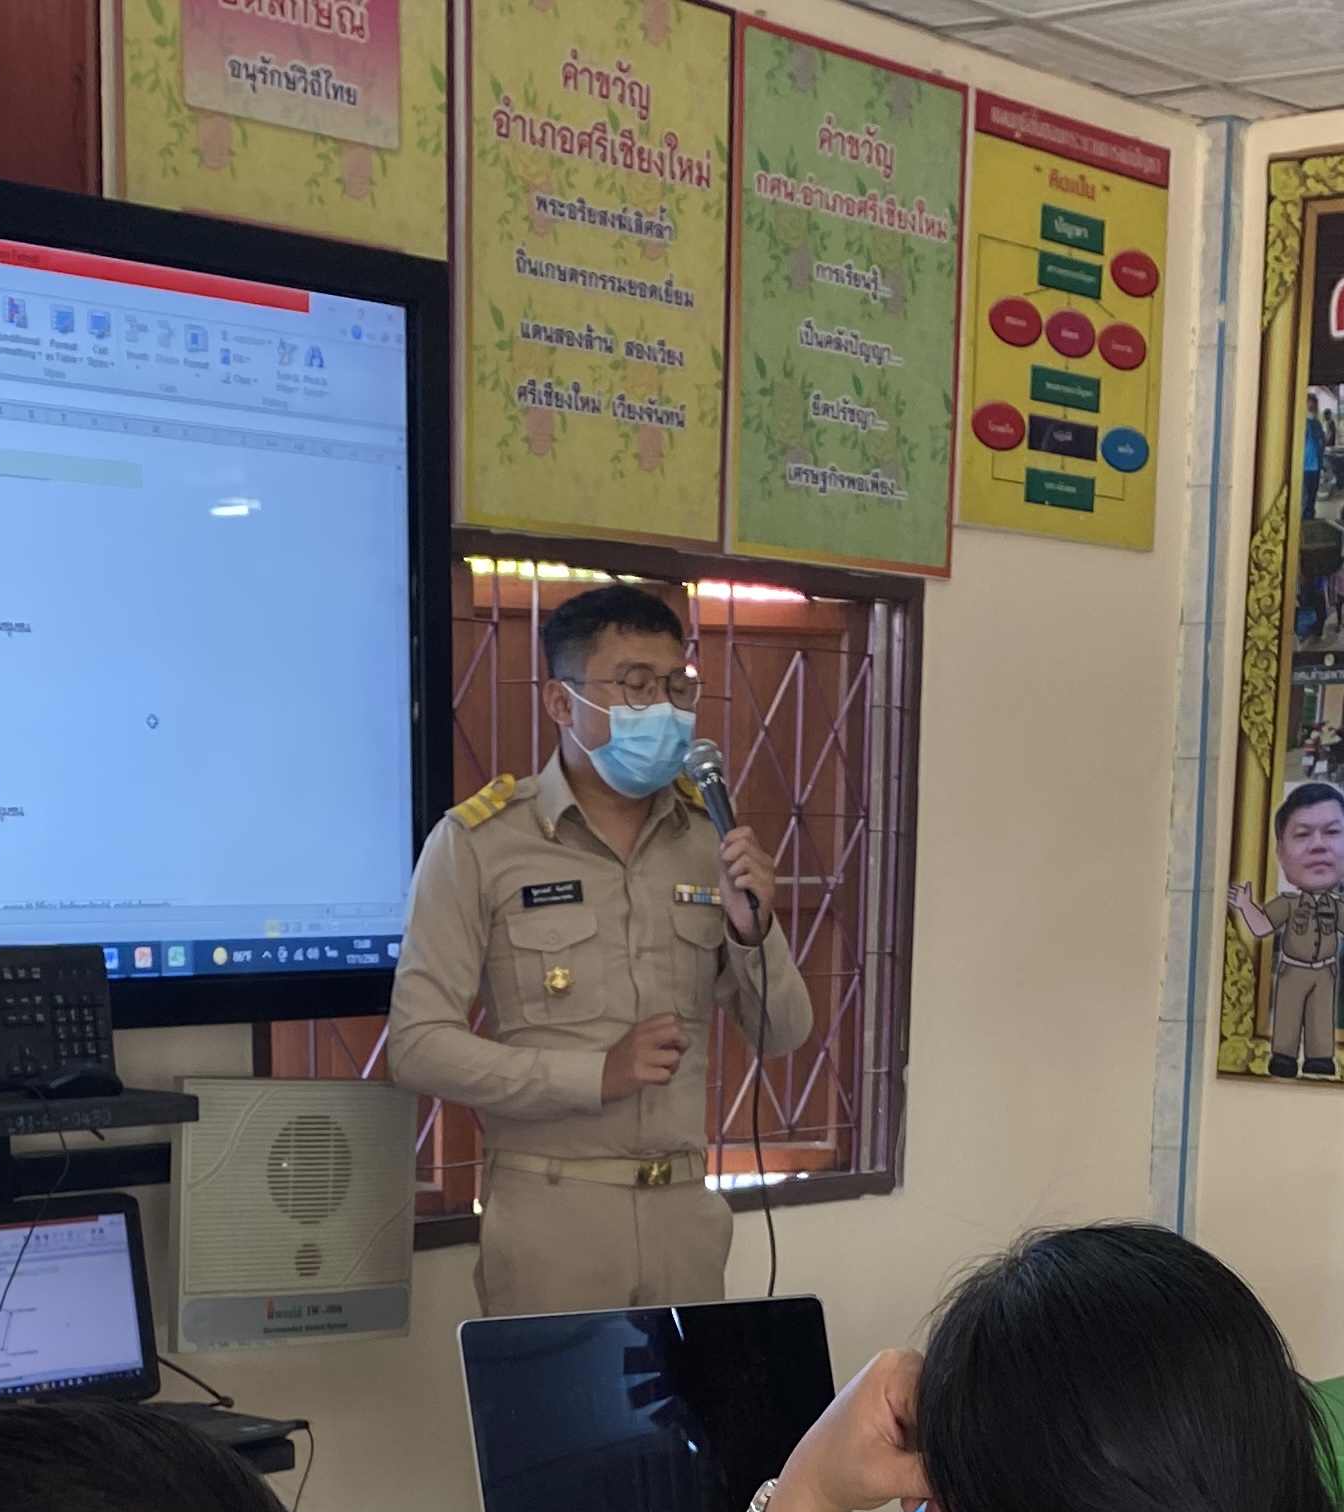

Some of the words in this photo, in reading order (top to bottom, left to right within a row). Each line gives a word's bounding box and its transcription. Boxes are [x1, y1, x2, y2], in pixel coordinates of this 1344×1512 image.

[228, 55, 357, 107] อนุรักษ์วิถีไทย
[561, 48, 651, 121] คำขวัญ
[492, 95, 711, 189] อำเภอศรีเชียงใหม่
[818, 114, 895, 180] คำขวัญ
[756, 174, 949, 241] กศน.อำเภอศรีเชียงใหม่
[517, 378, 602, 415] ศรีเชียงใหม่
[611, 393, 686, 428] เวียงจันทน์
